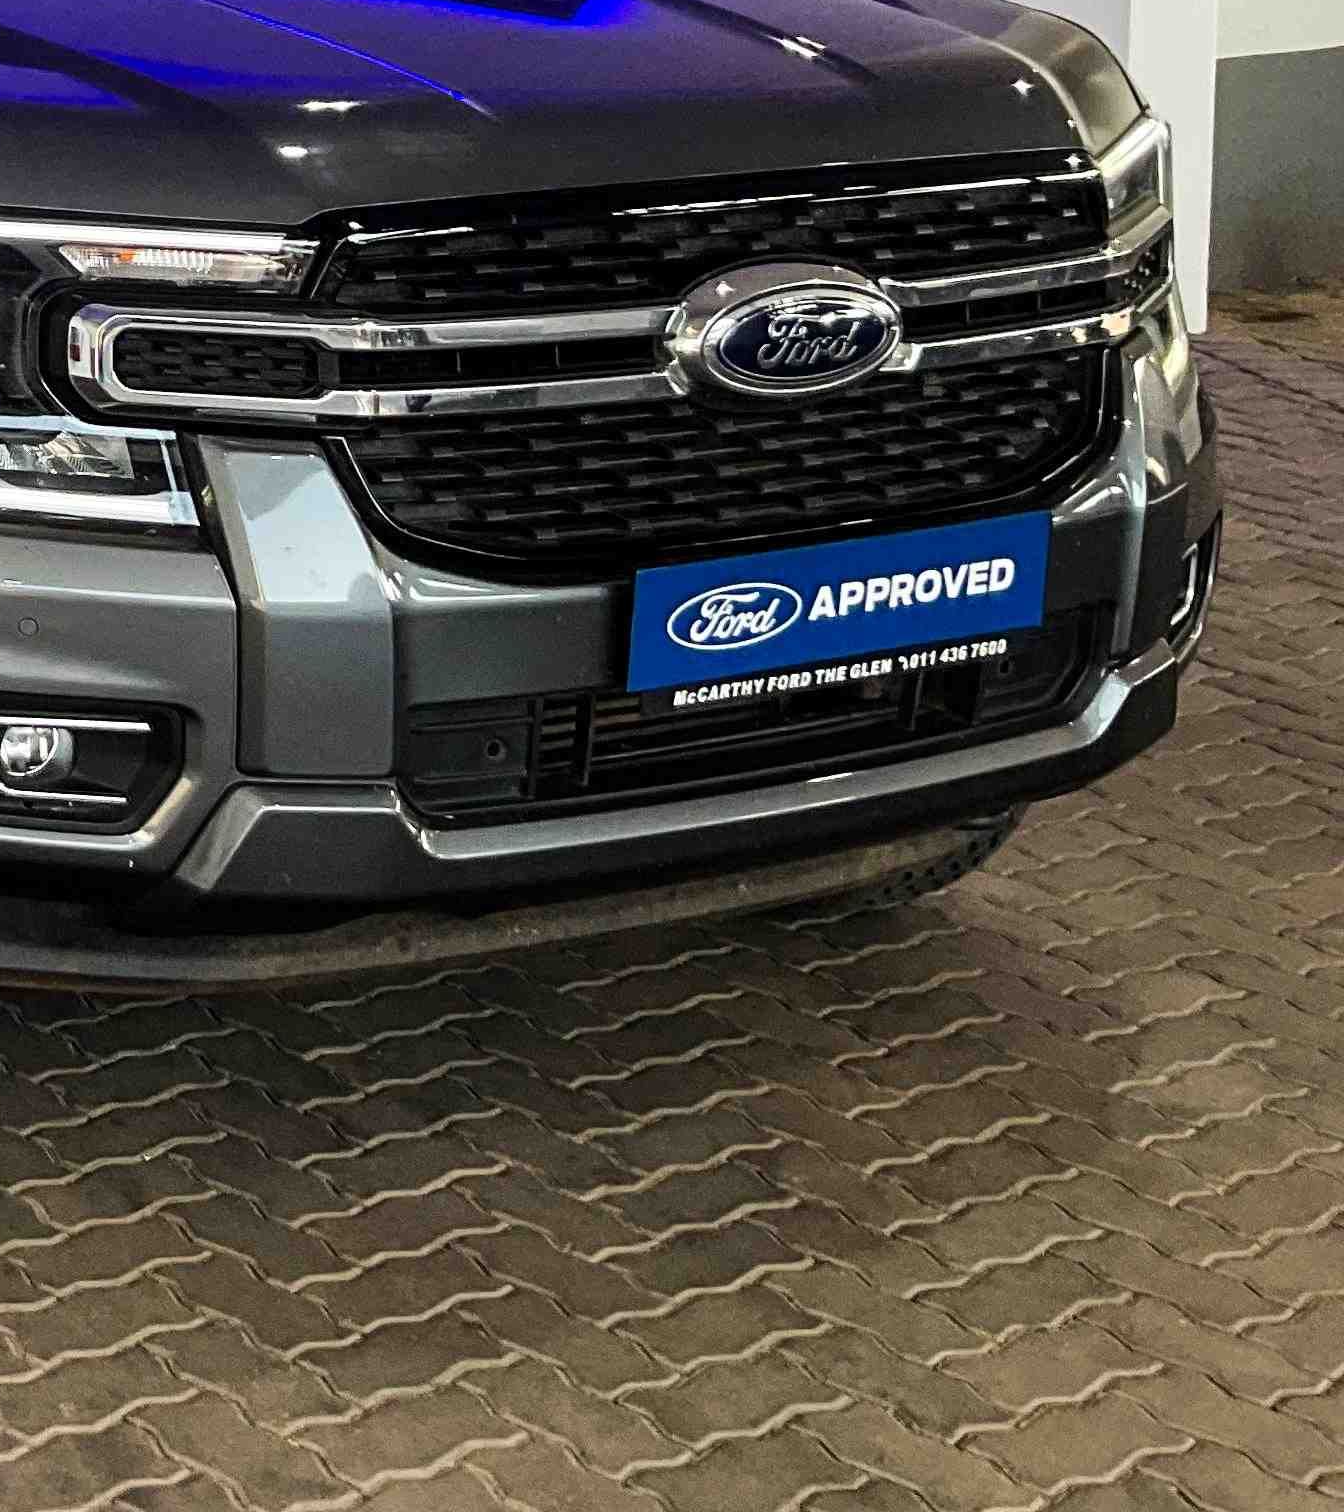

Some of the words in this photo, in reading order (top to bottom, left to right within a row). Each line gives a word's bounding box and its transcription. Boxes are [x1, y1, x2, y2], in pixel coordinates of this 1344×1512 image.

[757, 308, 861, 369] Ford
[689, 591, 780, 643] Ford
[808, 558, 1016, 622] APPROVED
[673, 678, 766, 707] McCARTHY
[767, 670, 812, 694] FORD
[815, 665, 848, 686] THE
[850, 657, 893, 680] GLEN
[909, 650, 937, 669] 011
[939, 646, 969, 663] 436
